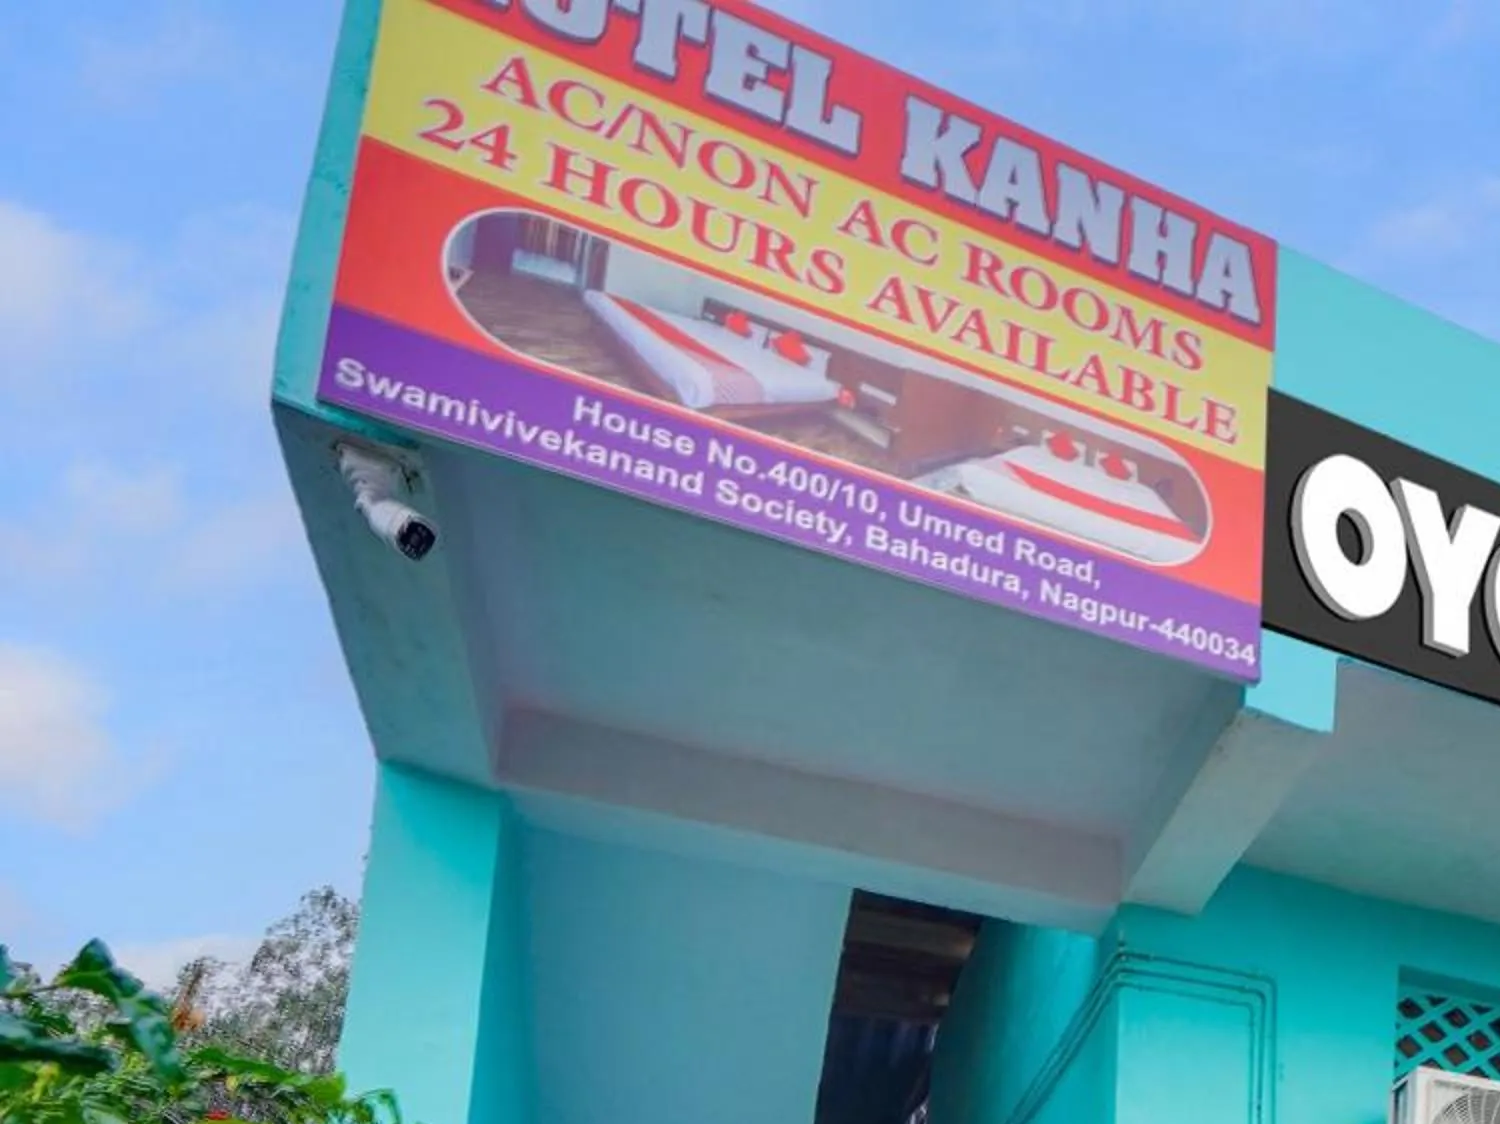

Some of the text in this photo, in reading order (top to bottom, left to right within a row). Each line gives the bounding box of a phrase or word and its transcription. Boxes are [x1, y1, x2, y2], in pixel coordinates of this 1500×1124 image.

[418, 98, 1239, 446] 24 HOURS AVAILABLE
[470, 0, 1263, 328] TEL KANHA
[481, 56, 1204, 371] AC/NON AC ROOMS
[334, 357, 1257, 666] Swamivivekanand Society, Bahadura, Nagpur-440034
[573, 396, 1101, 590] House No.400/10, Umred Road,
